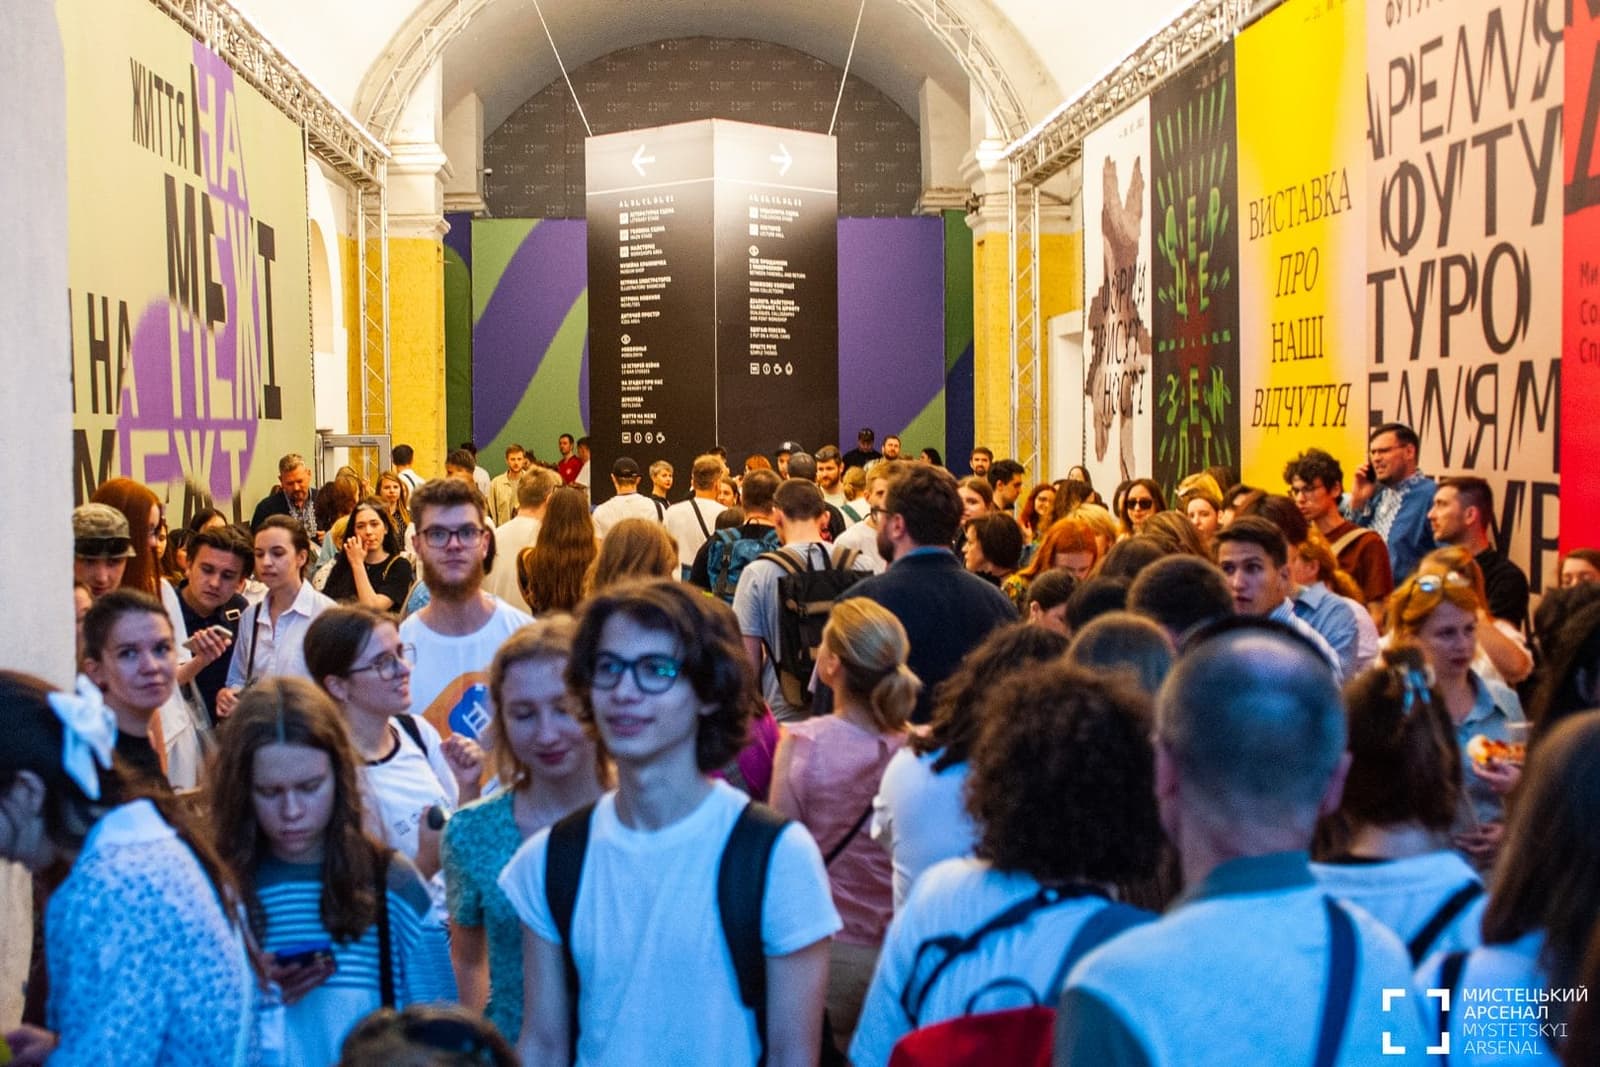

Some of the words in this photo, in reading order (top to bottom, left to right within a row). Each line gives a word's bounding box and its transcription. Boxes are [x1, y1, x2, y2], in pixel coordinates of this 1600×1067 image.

[129, 56, 187, 171] ЖИТТЯ
[190, 63, 249, 205] НА
[1249, 167, 1353, 241] ВИСТАВКА
[1275, 247, 1320, 299] ПРО
[87, 292, 140, 417] НА
[1271, 315, 1325, 364] НАШІ
[1251, 383, 1352, 434] ВІДЧУТТЯ
